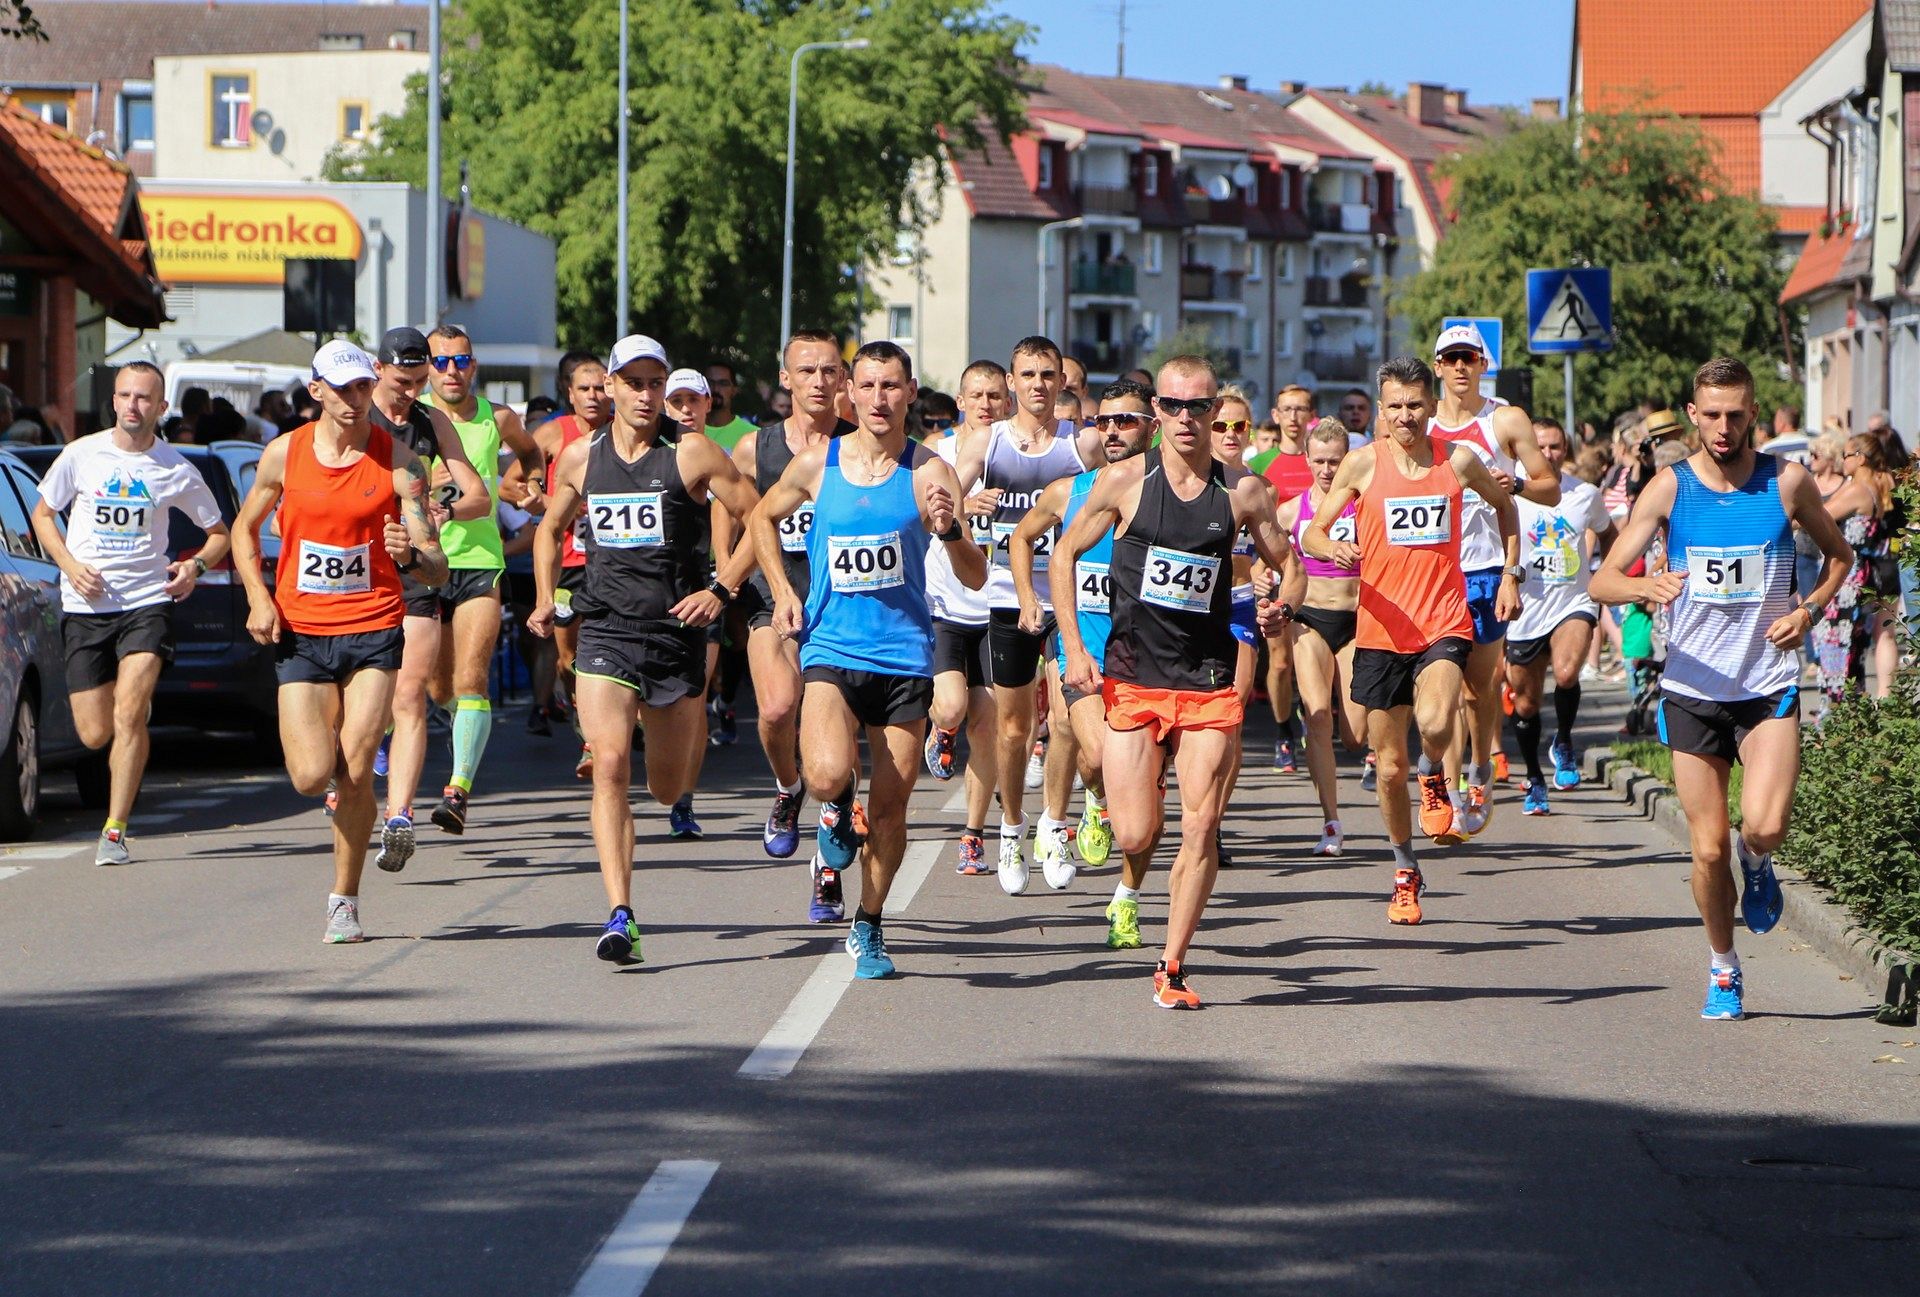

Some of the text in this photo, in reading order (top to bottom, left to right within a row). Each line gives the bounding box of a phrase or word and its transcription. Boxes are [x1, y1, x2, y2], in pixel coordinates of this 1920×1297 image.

[95, 506, 145, 527] 501
[594, 504, 657, 530] 216
[1391, 505, 1447, 530] 207
[997, 533, 1050, 556] 42
[304, 553, 366, 579] 284
[834, 545, 897, 574] 400
[1706, 558, 1743, 585] 51
[1150, 559, 1212, 594] 343
